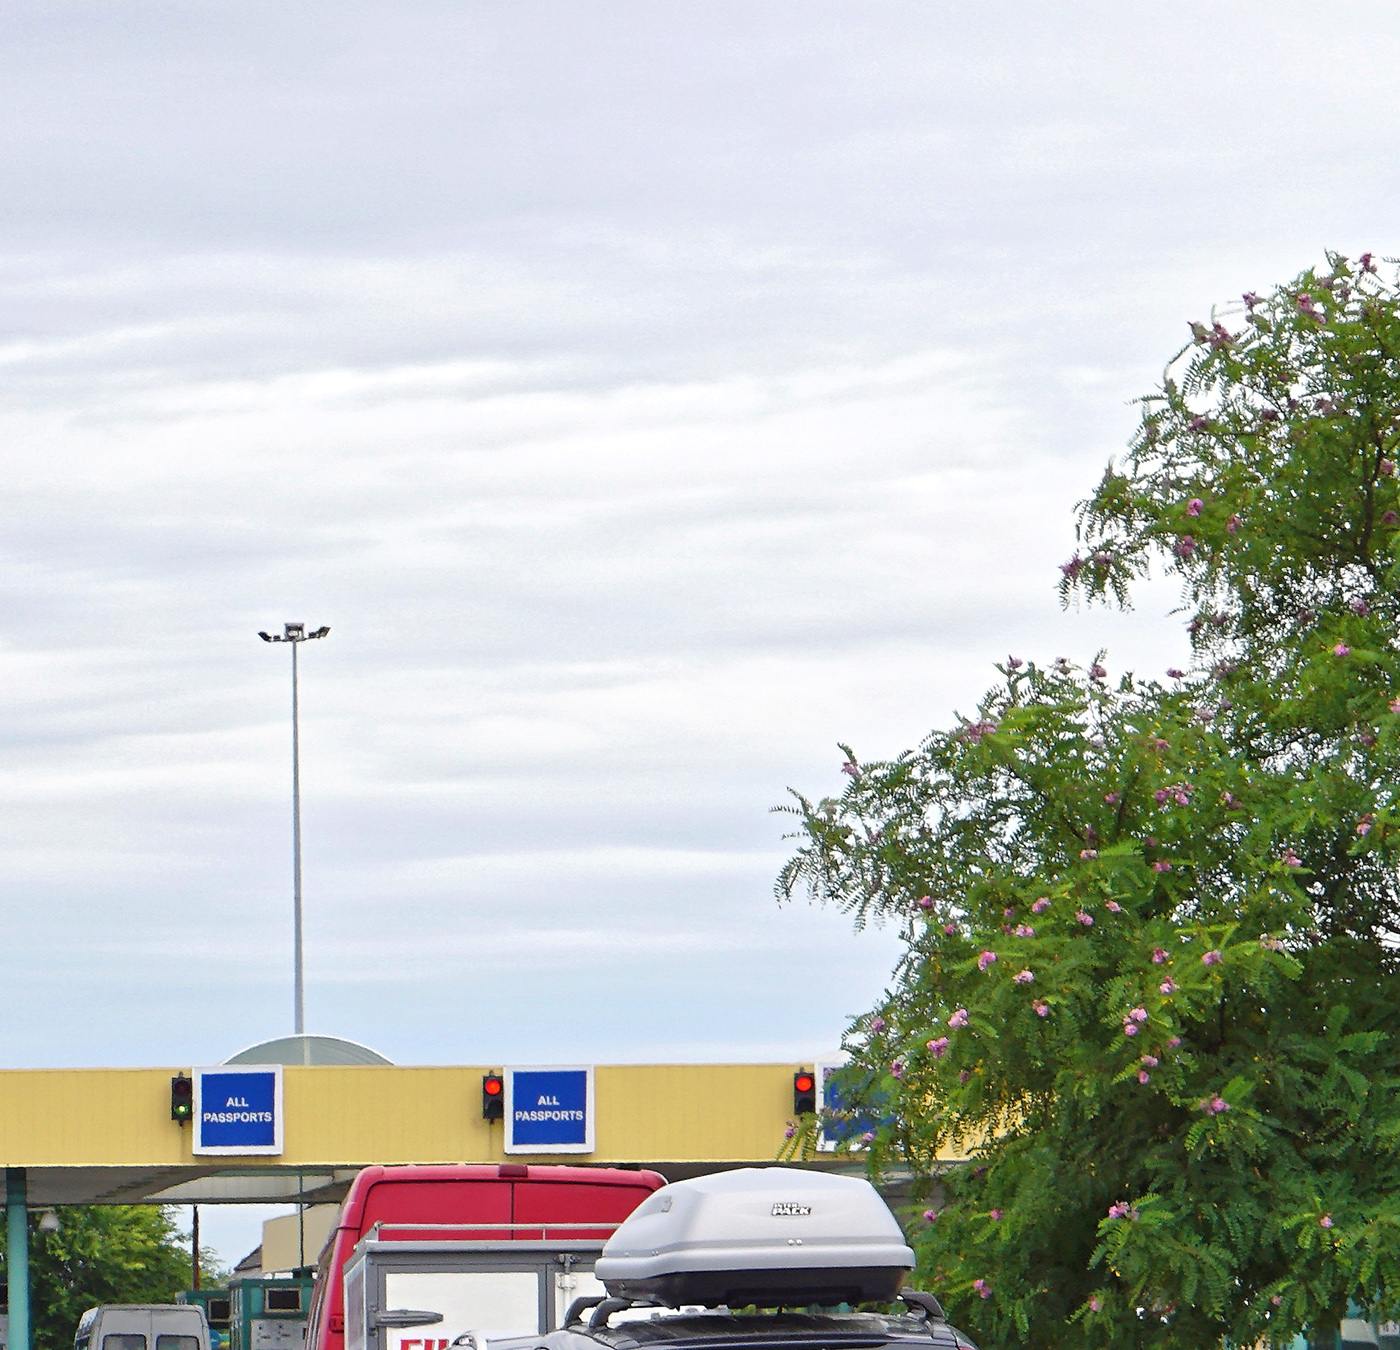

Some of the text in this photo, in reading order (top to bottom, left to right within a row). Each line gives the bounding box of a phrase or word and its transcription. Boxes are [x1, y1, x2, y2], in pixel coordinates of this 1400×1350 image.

[226, 1097, 249, 1107] ALL
[537, 1095, 560, 1106] ALL
[203, 1112, 272, 1123] PASSPORTS
[515, 1110, 583, 1121] PASSPORTS
